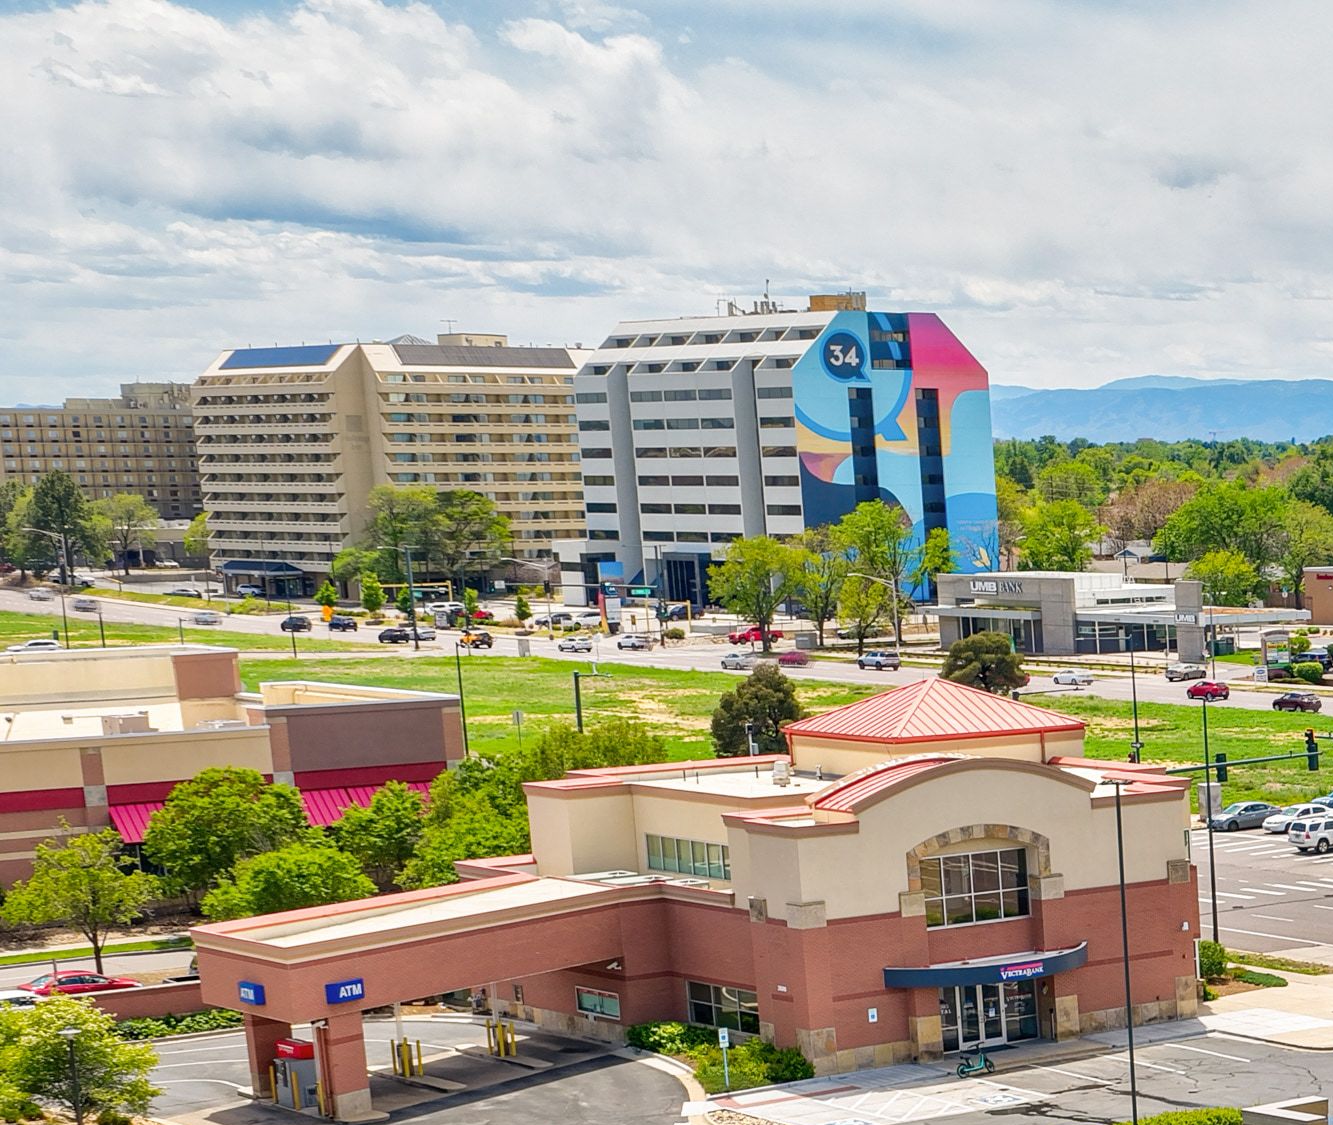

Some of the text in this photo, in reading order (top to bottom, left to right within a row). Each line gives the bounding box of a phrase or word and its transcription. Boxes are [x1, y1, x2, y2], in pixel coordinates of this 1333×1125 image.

[829, 344, 860, 366] 34
[970, 581, 1023, 594] UMB BANK
[1175, 614, 1196, 624] UMB
[240, 987, 255, 1001] ATM
[338, 983, 362, 999] ATM
